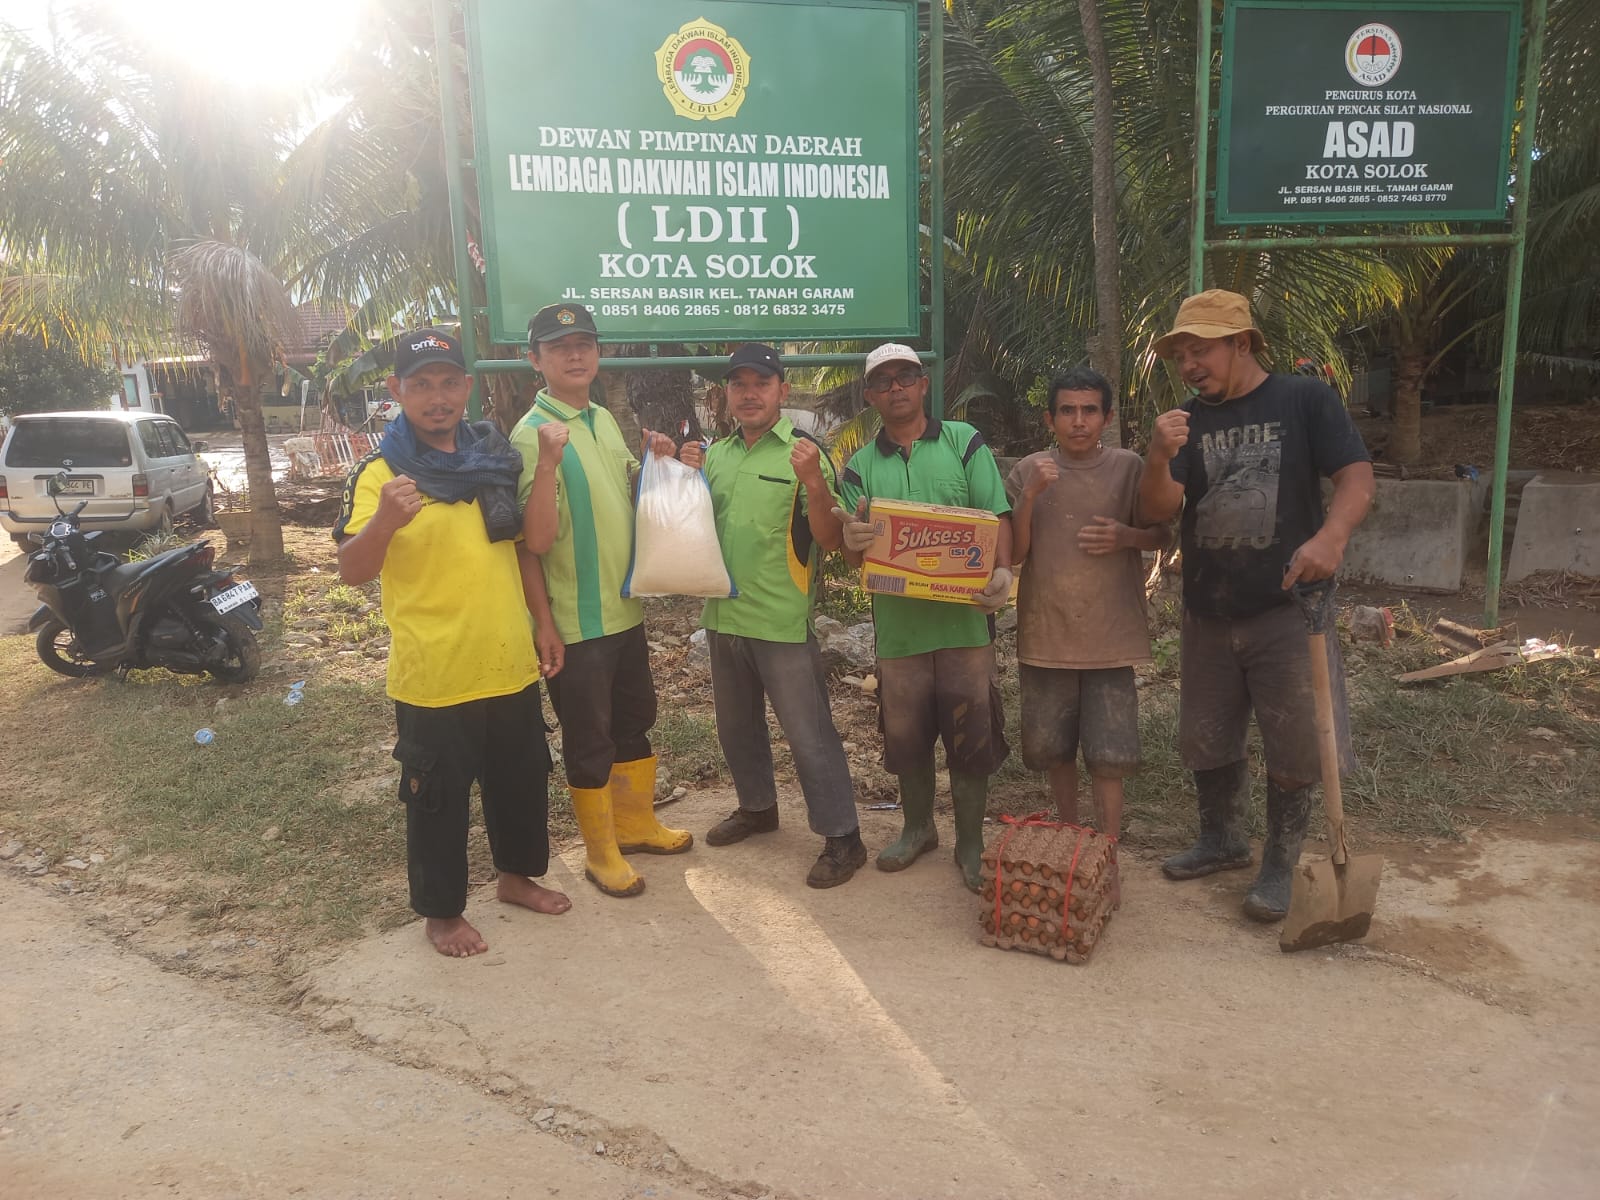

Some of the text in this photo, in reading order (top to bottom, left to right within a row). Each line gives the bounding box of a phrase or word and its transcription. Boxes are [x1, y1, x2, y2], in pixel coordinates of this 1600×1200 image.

[665, 30, 742, 96] LEMBAGA DAKWAH ISLAM INDONESIA
[1325, 90, 1417, 100] PENGURUS KOTA
[689, 102, 718, 113] LDII
[1265, 104, 1472, 116] PERGURUAN PENCAK SILAT NASIONAL
[538, 126, 862, 157] DEWAN PIMPINAN DAERAH
[1322, 120, 1415, 158] ASAD
[508, 154, 890, 200] LEMBAGA DAKWAH ISLAM INDONESIA
[1305, 164, 1428, 179] KOTA SOLOK
[1294, 186, 1332, 194] SERSAN
[651, 205, 768, 243] LDII
[598, 253, 818, 278] KOTA SOLOK
[562, 288, 854, 299] JL. SERSAN BASIR KEL. TANAH GARAM
[582, 304, 597, 316] P.
[602, 304, 638, 316] 0851
[643, 304, 680, 316] 8406
[684, 304, 720, 316] 2865
[733, 304, 768, 316] 0812
[773, 304, 807, 315] 6832
[812, 304, 846, 315] 3475
[950, 546, 982, 568] ISI 2
